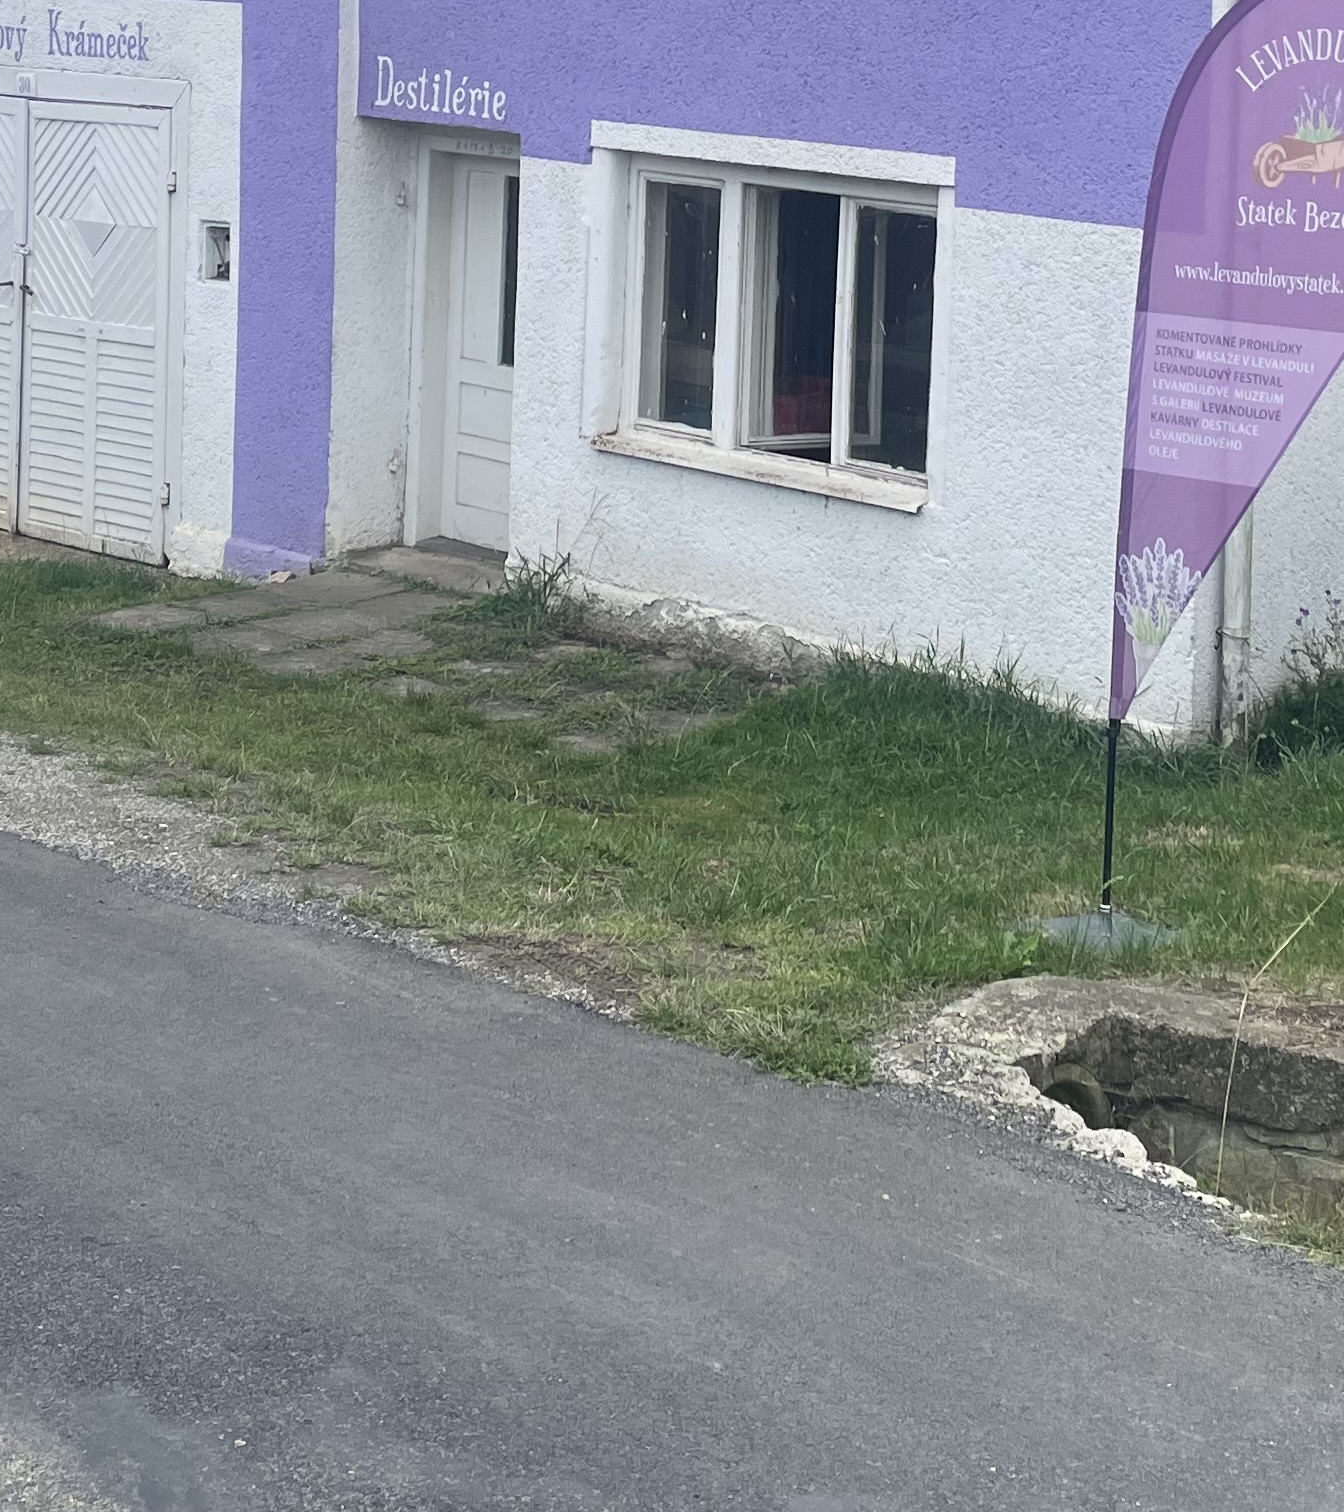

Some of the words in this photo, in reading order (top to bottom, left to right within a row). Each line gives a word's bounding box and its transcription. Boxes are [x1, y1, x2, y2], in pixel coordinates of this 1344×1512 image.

[47, 7, 150, 62] Krámeček
[18, 76, 31, 94] 30
[374, 55, 507, 121] Destilérie
[1236, 196, 1297, 227] Statek
[1156, 328, 1237, 348] KOMENTOVANÉ
[1239, 337, 1303, 355] PROHLÍDKY
[1154, 345, 1194, 359] STATKU
[1242, 355, 1250, 366] V
[1252, 356, 1315, 374] LEVANDULI
[1153, 361, 1232, 381] LEVANDULOVÝ
[1234, 371, 1283, 388] FESTIVAL
[1152, 378, 1230, 398] LEVANDULOVÉ
[1234, 389, 1284, 405] MUZEUM
[1151, 394, 1158, 405] S
[1202, 402, 1282, 422] LEVANDULOVÉ
[1150, 411, 1199, 428] KAVÁRNY
[1201, 418, 1259, 437] DESTILACE
[1148, 444, 1179, 460] OLEJE
[1149, 428, 1243, 451] LEVANDULOVÉHO
